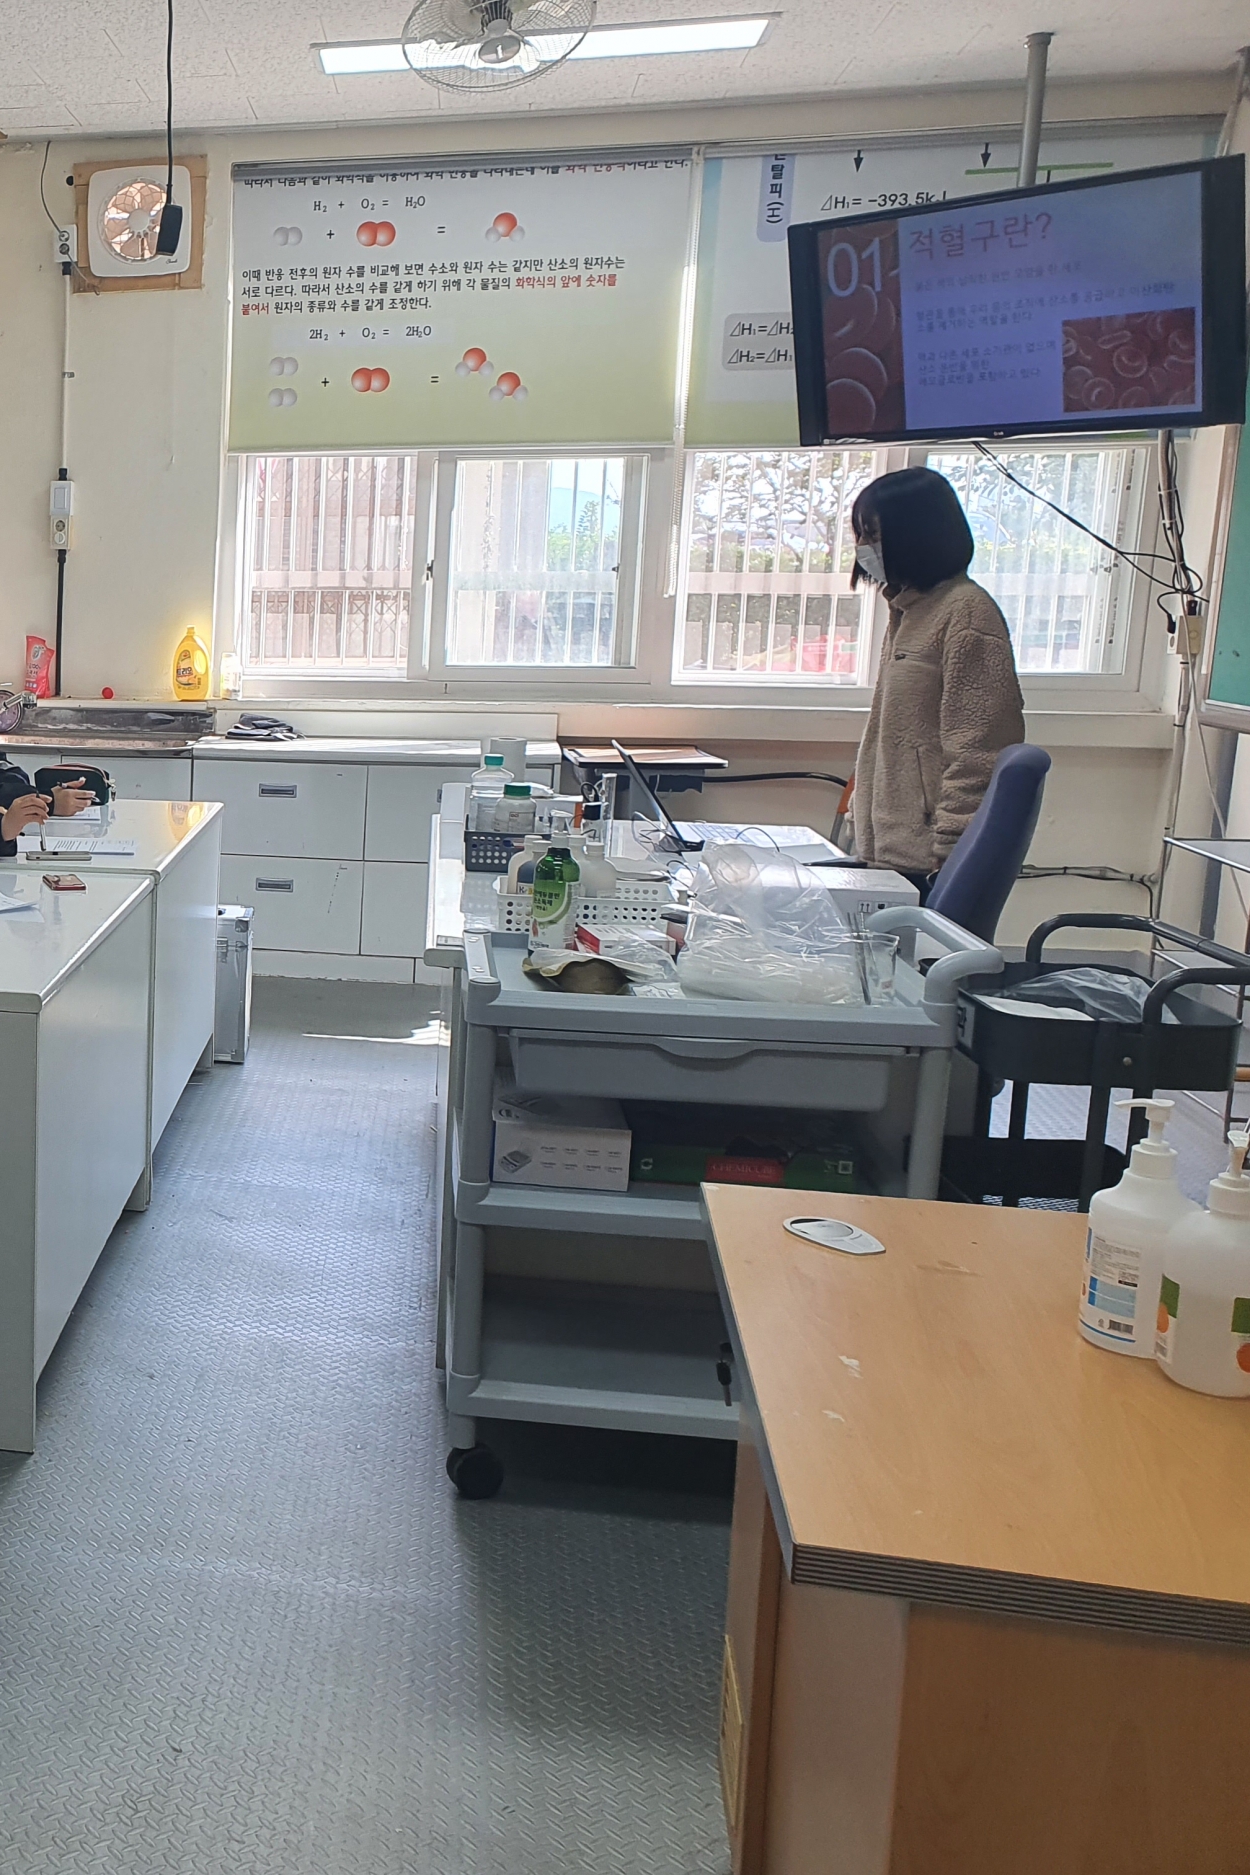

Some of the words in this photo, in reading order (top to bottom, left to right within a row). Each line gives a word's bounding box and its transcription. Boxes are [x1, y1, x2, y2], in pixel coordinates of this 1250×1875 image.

[909, 212, 1053, 261] 적혈구란?
[242, 269, 261, 282] 이때
[265, 268, 285, 282] 반응
[289, 266, 319, 280] 전후의
[322, 265, 342, 279] 원자
[346, 264, 365, 278] 수를
[370, 262, 401, 277] 비교해
[404, 262, 424, 276] 보면
[428, 260, 459, 275] 수소와
[463, 260, 483, 274] 원자
[487, 259, 508, 273] 수는
[513, 258, 544, 272] 같지만
[547, 257, 579, 271] 산소의
[583, 255, 625, 270] 원자수는
[827, 238, 883, 297] 01
[241, 285, 261, 298] 서로
[265, 284, 296, 297] 다르다.
[301, 282, 331, 296] 따라서
[334, 281, 365, 295] 산소의
[369, 280, 389, 294] 수를
[393, 279, 414, 293] 같게
[417, 279, 437, 292] 하기
[441, 278, 462, 292] 위해
[466, 278, 476, 291] 각
[480, 276, 511, 290] 물질의
[515, 275, 557, 289] 화학식의
[560, 275, 581, 288] 앞에
[585, 273, 617, 287] 숫자를
[241, 302, 270, 315] 붙여서
[273, 300, 303, 314] 원자의
[306, 300, 337, 313] 종류와
[340, 299, 361, 312] 수를
[364, 298, 385, 312] 같게
[388, 296, 431, 310] 조정한다.
